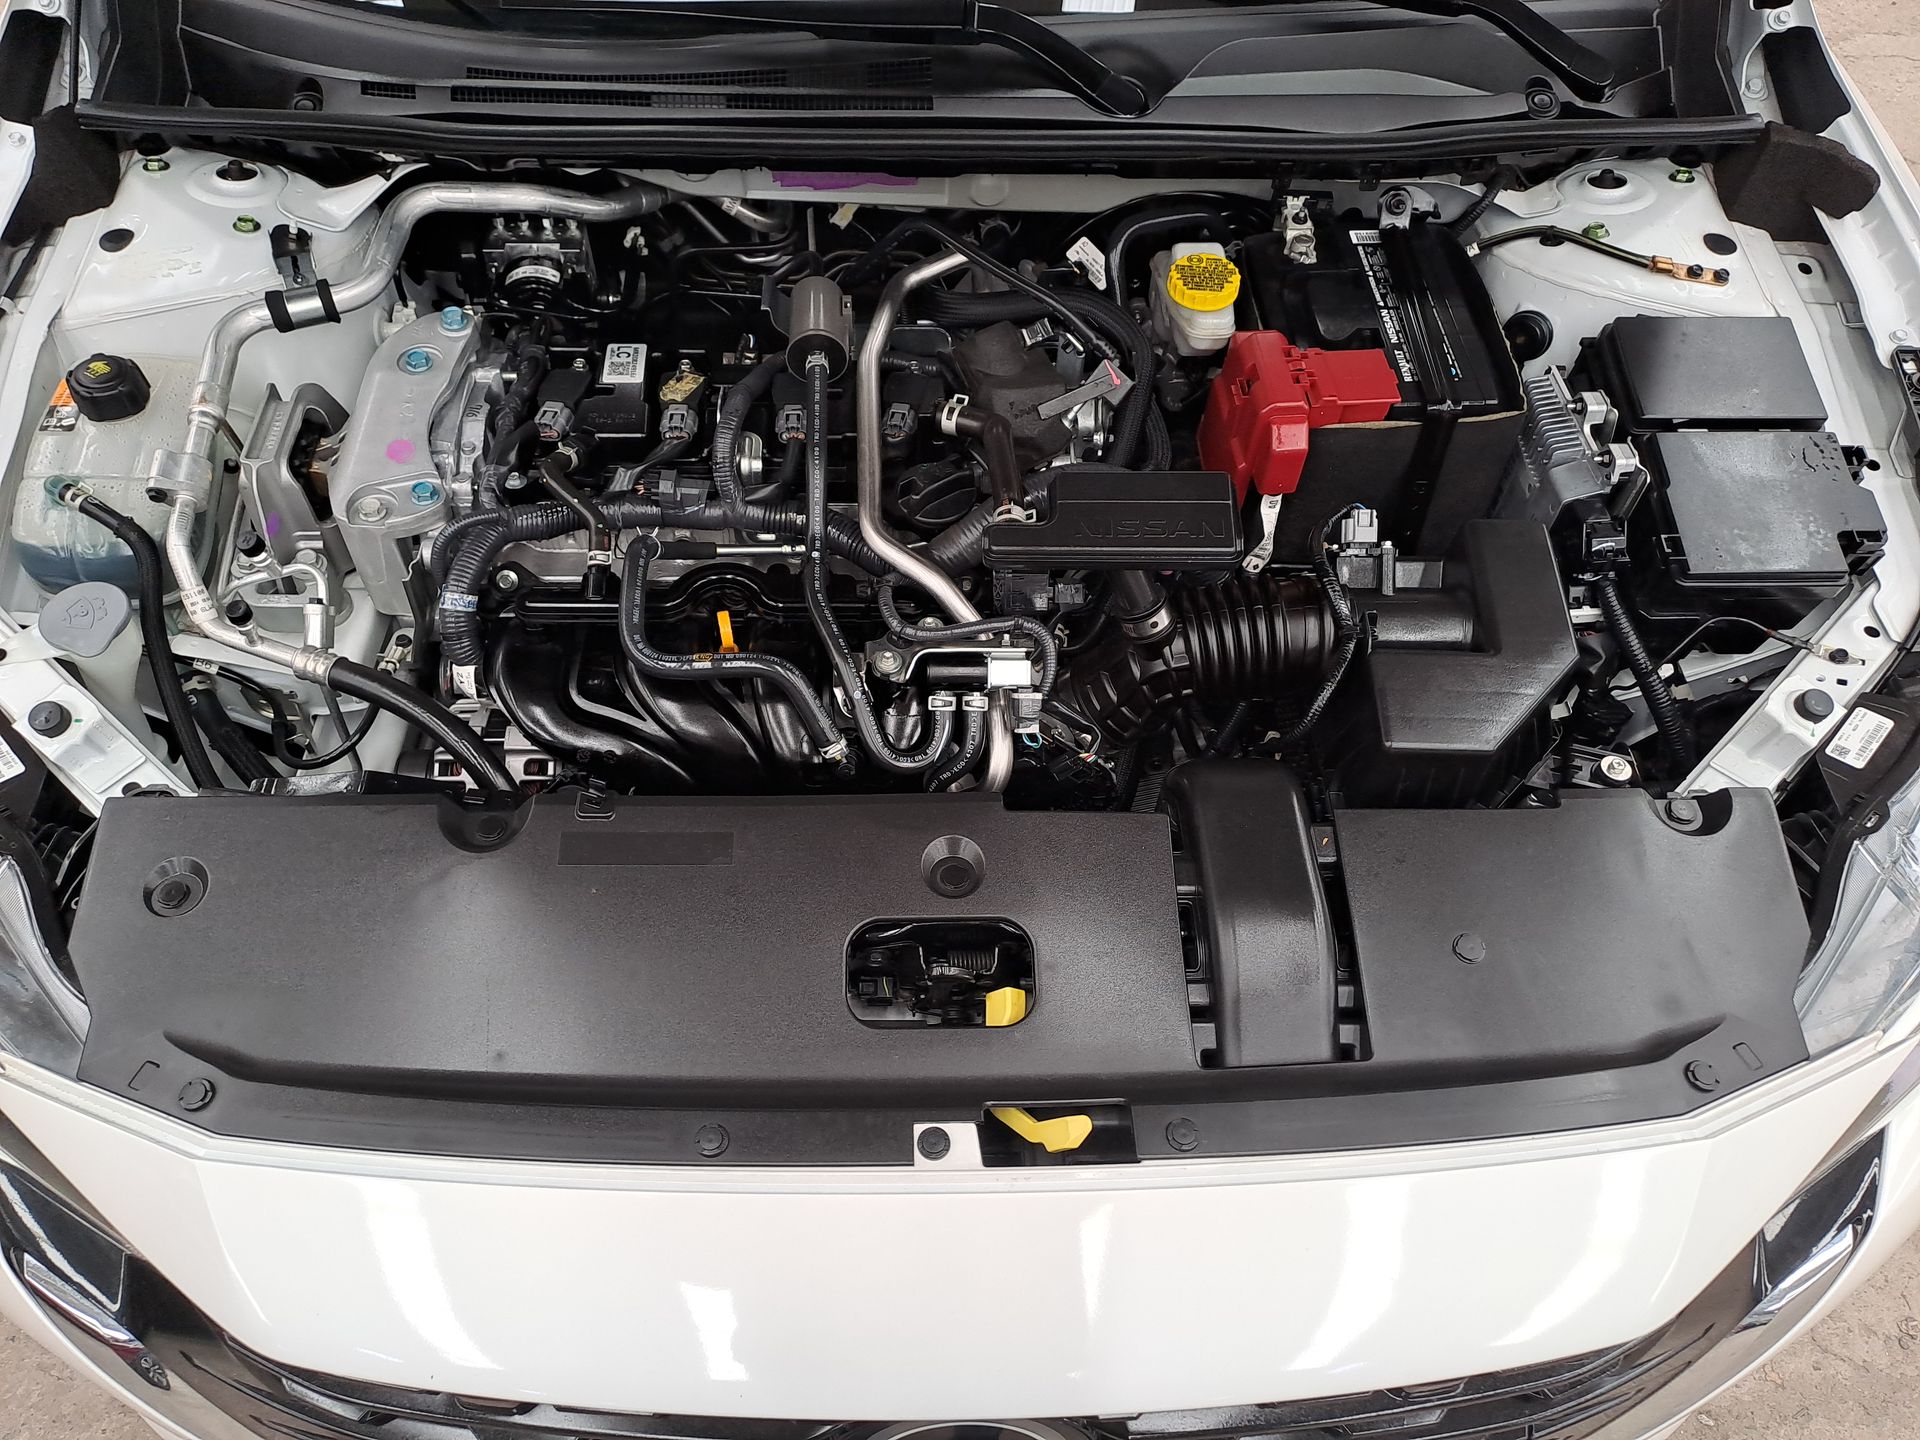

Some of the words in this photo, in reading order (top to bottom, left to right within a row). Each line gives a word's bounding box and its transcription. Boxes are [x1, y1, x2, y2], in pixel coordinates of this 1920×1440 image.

[1380, 309, 1399, 344] NISSAN
[616, 346, 632, 359] LC
[1394, 349, 1413, 382] RENAULT
[1075, 519, 1225, 538] NISSAN
